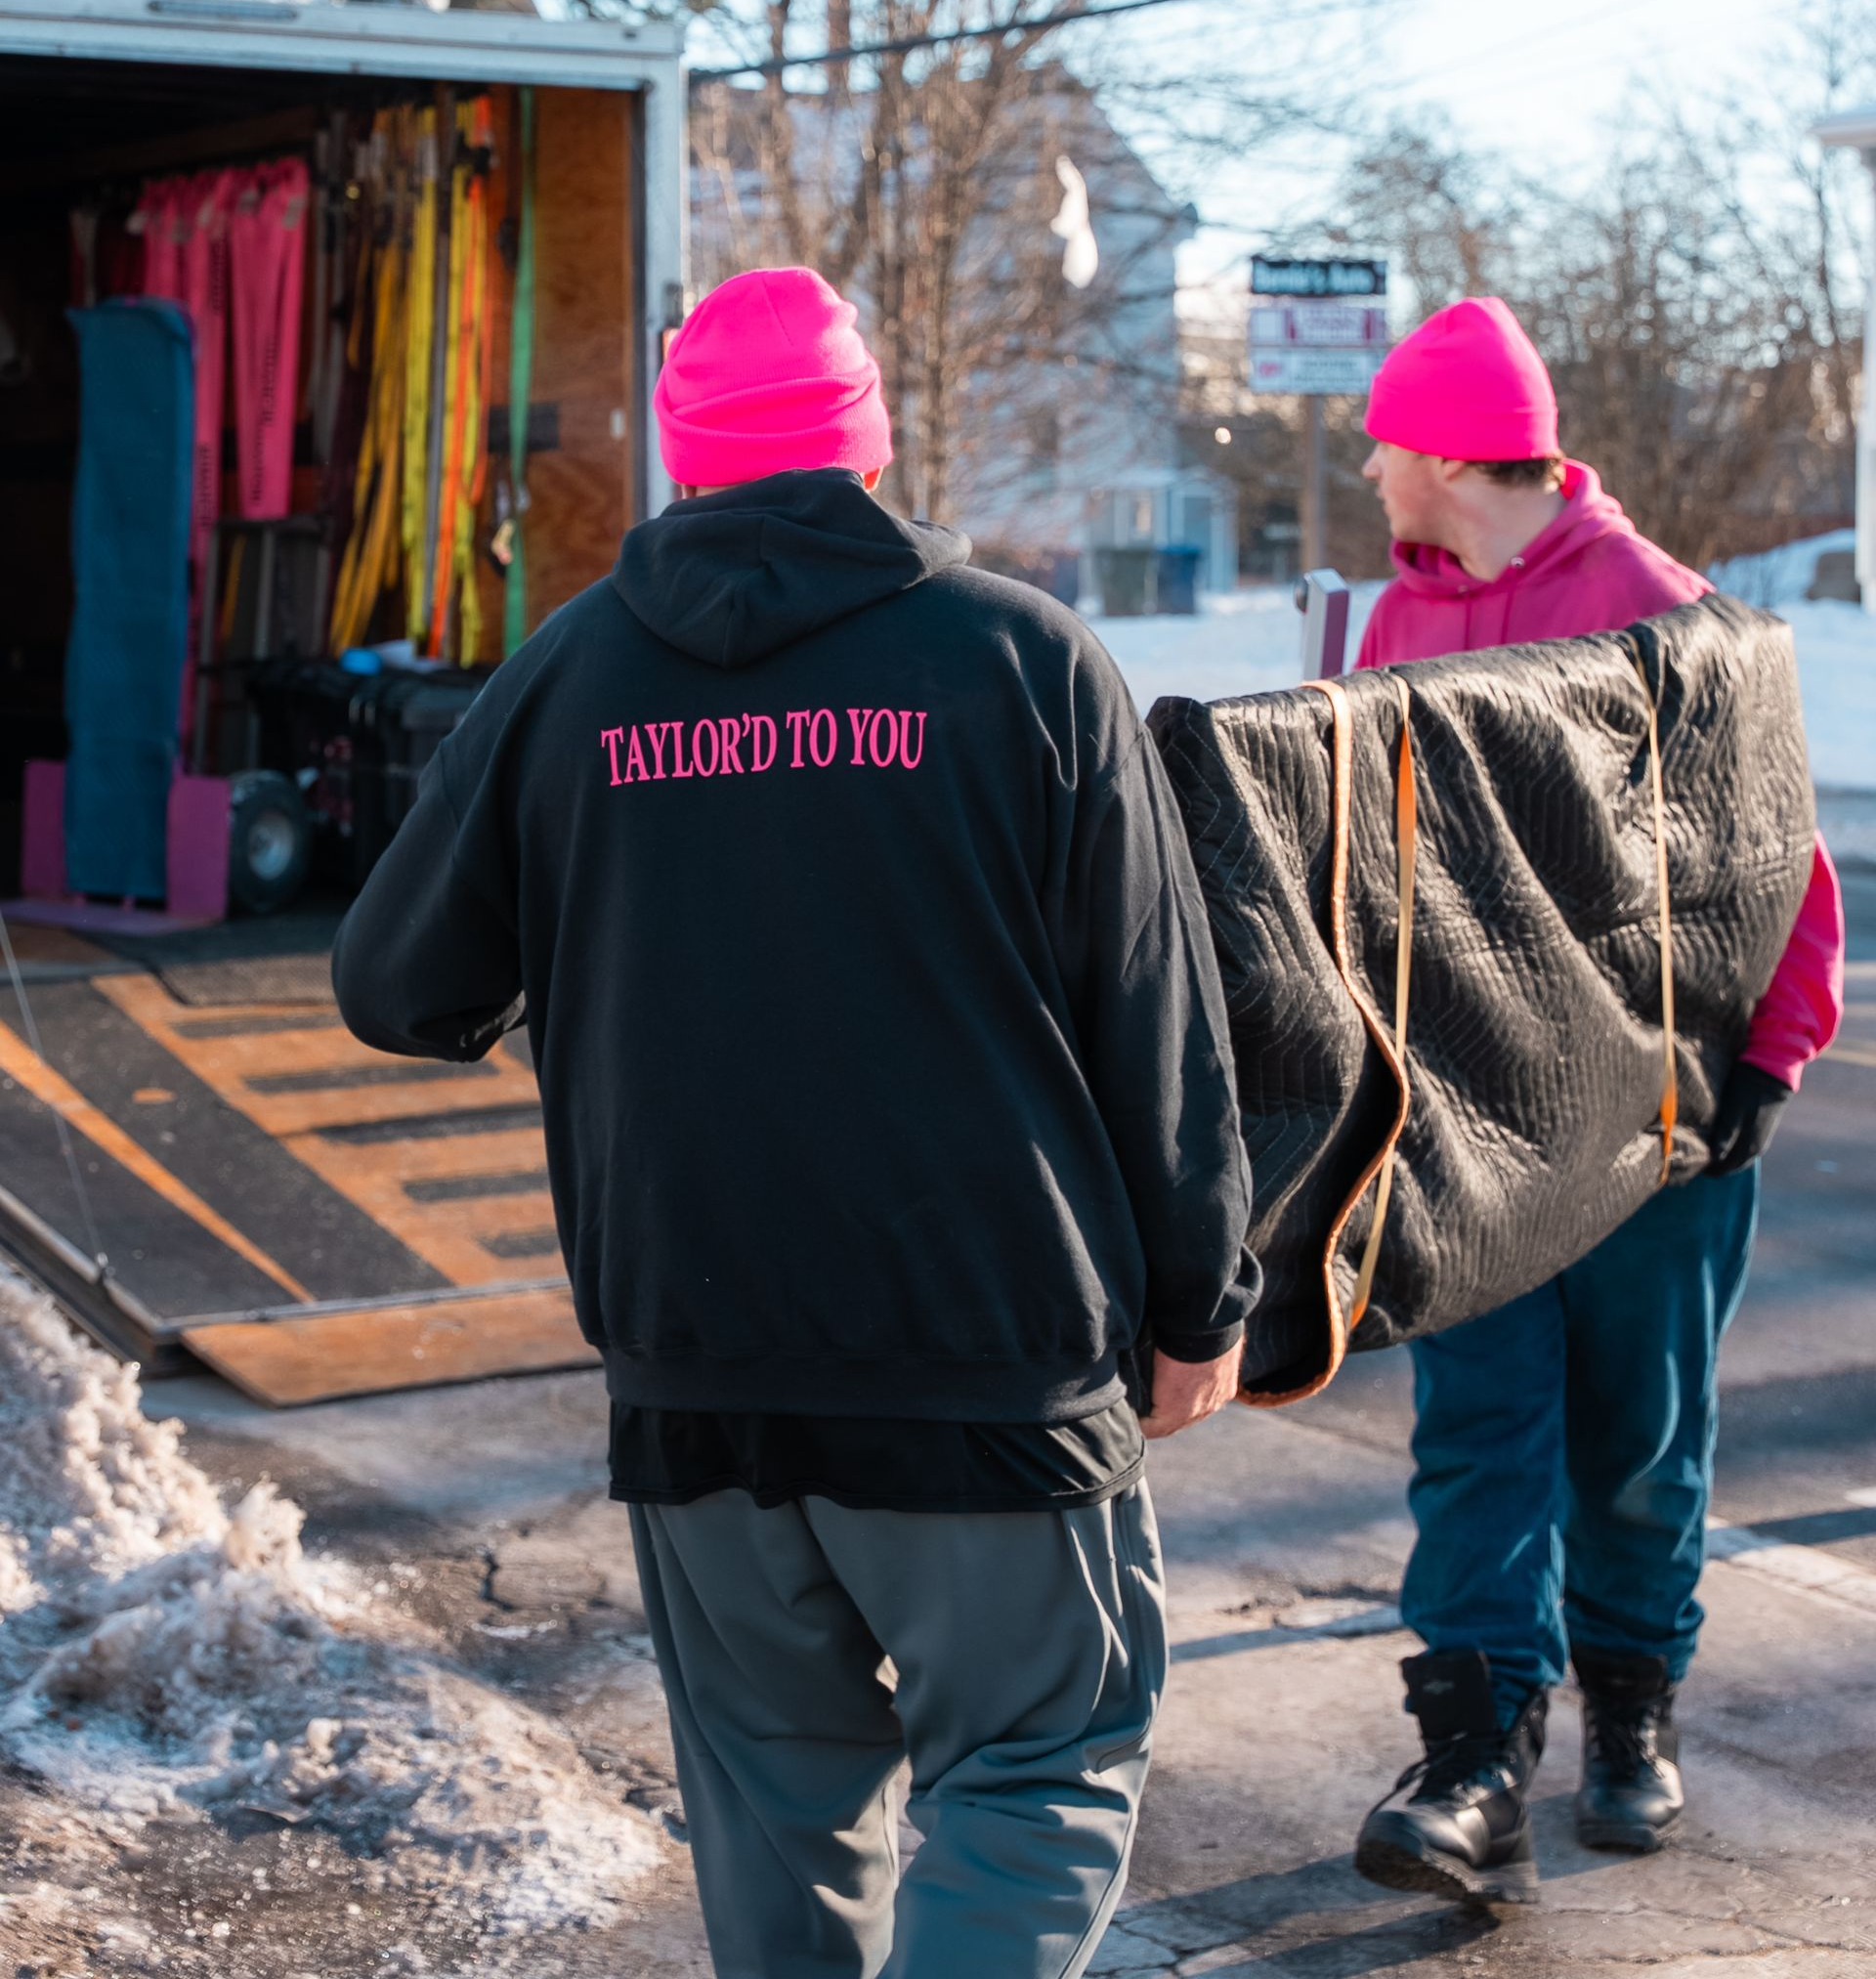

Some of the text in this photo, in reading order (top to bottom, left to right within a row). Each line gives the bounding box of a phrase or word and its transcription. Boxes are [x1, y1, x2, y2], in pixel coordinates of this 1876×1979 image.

[601, 709, 927, 786] TAYLOR'D TO YOU
